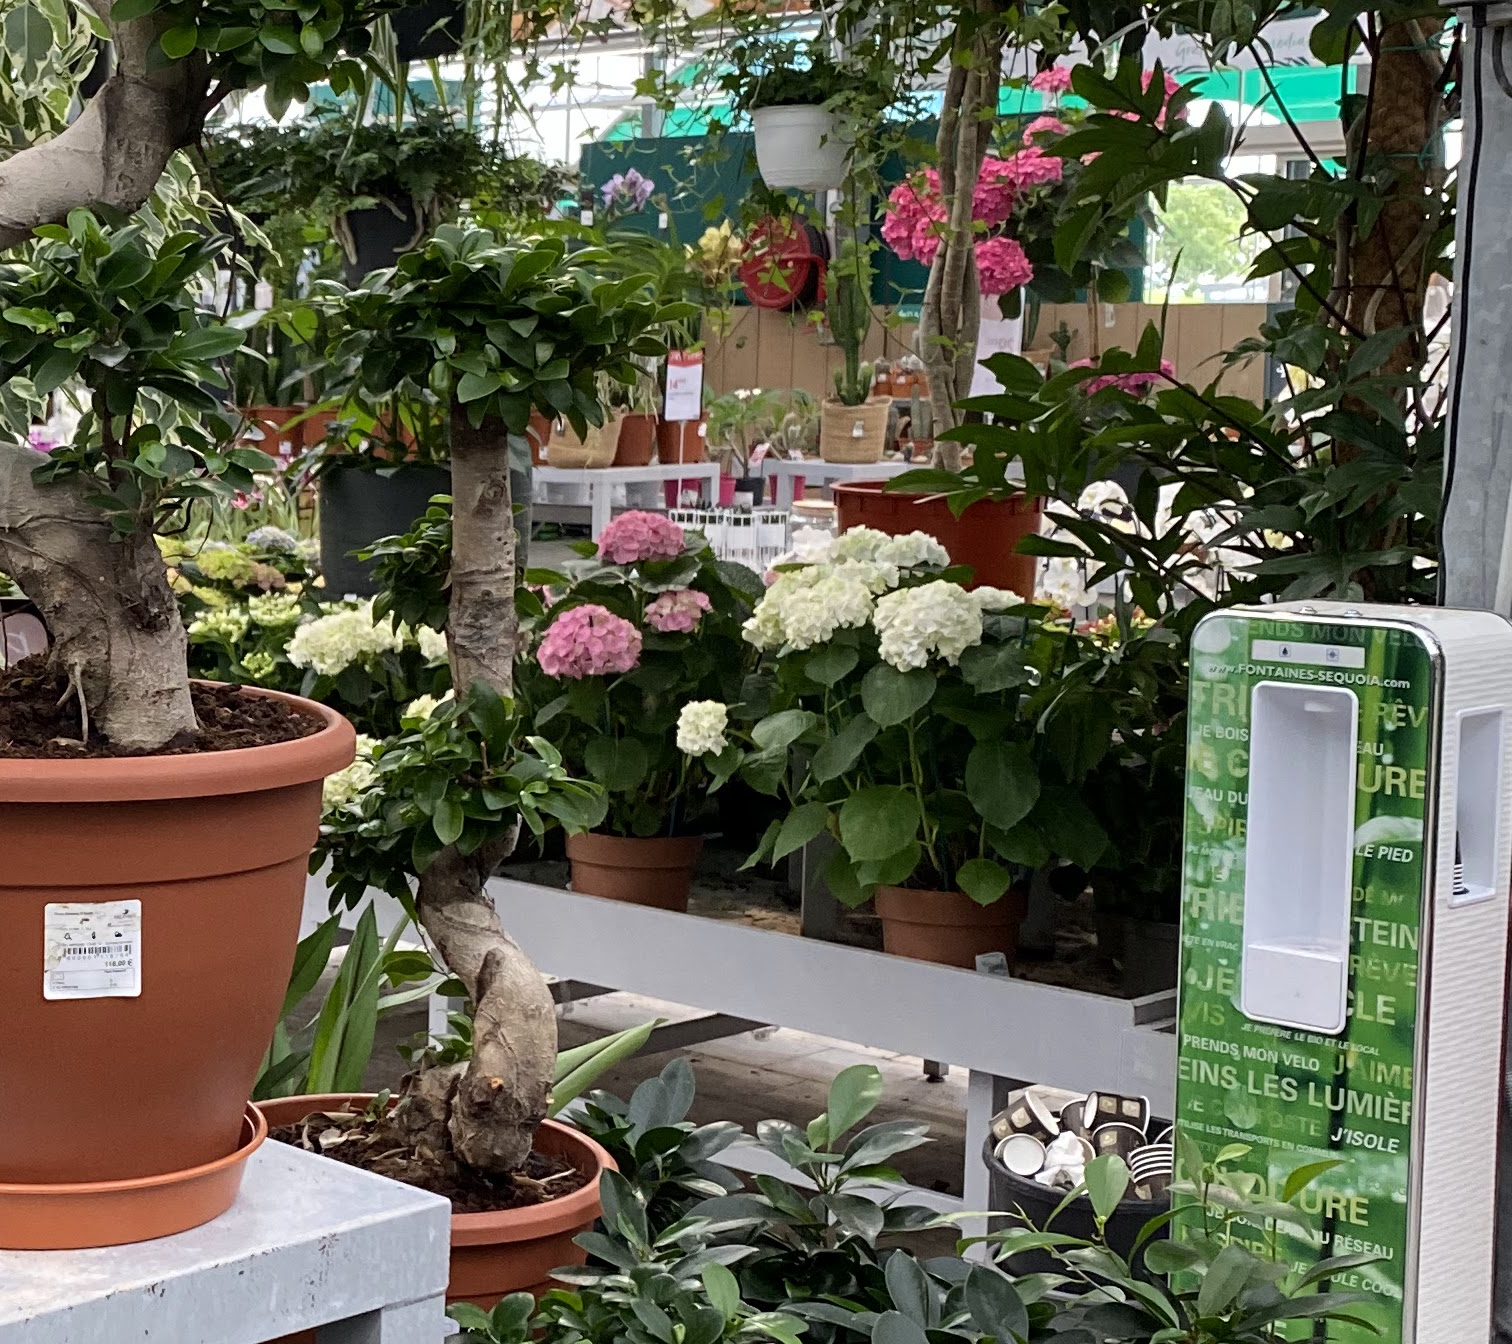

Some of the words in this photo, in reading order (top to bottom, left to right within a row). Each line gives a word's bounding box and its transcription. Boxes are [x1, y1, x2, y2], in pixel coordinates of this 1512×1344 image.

[1215, 726, 1249, 742] BOIS
[1357, 763, 1426, 799] URE
[1227, 790, 1248, 805] DU
[1377, 846, 1414, 863] PIED
[1184, 1034, 1239, 1057] PRENDS
[1243, 1045, 1279, 1064] MON
[1294, 1032, 1306, 1042] LE
[1325, 1039, 1337, 1048] ET
[1247, 1070, 1299, 1102] LES
[1206, 1123, 1223, 1136] LES
[1223, 1127, 1281, 1148] TRANSPORTS
[1281, 1141, 1294, 1151] EN
[1331, 1127, 1400, 1154] J'ISOLE
[1334, 1233, 1394, 1260] RÉSEAU
